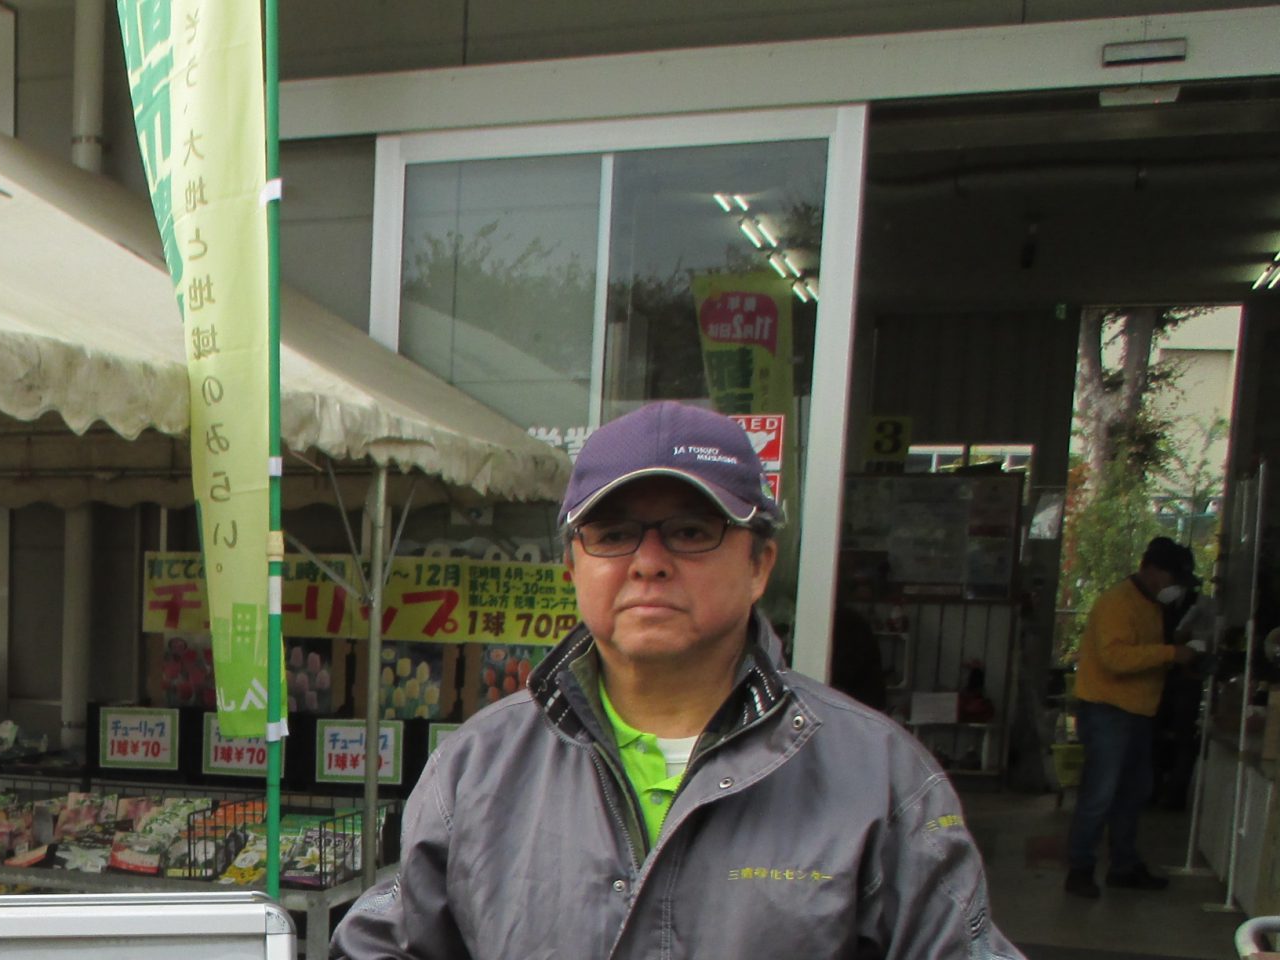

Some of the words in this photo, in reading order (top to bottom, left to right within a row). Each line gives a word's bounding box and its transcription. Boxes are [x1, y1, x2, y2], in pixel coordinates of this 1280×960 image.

[737, 418, 778, 430] AED
[873, 420, 903, 455] 3
[673, 446, 685, 456] JA
[688, 446, 720, 456] TOKYO
[112, 719, 166, 738] チューリップ
